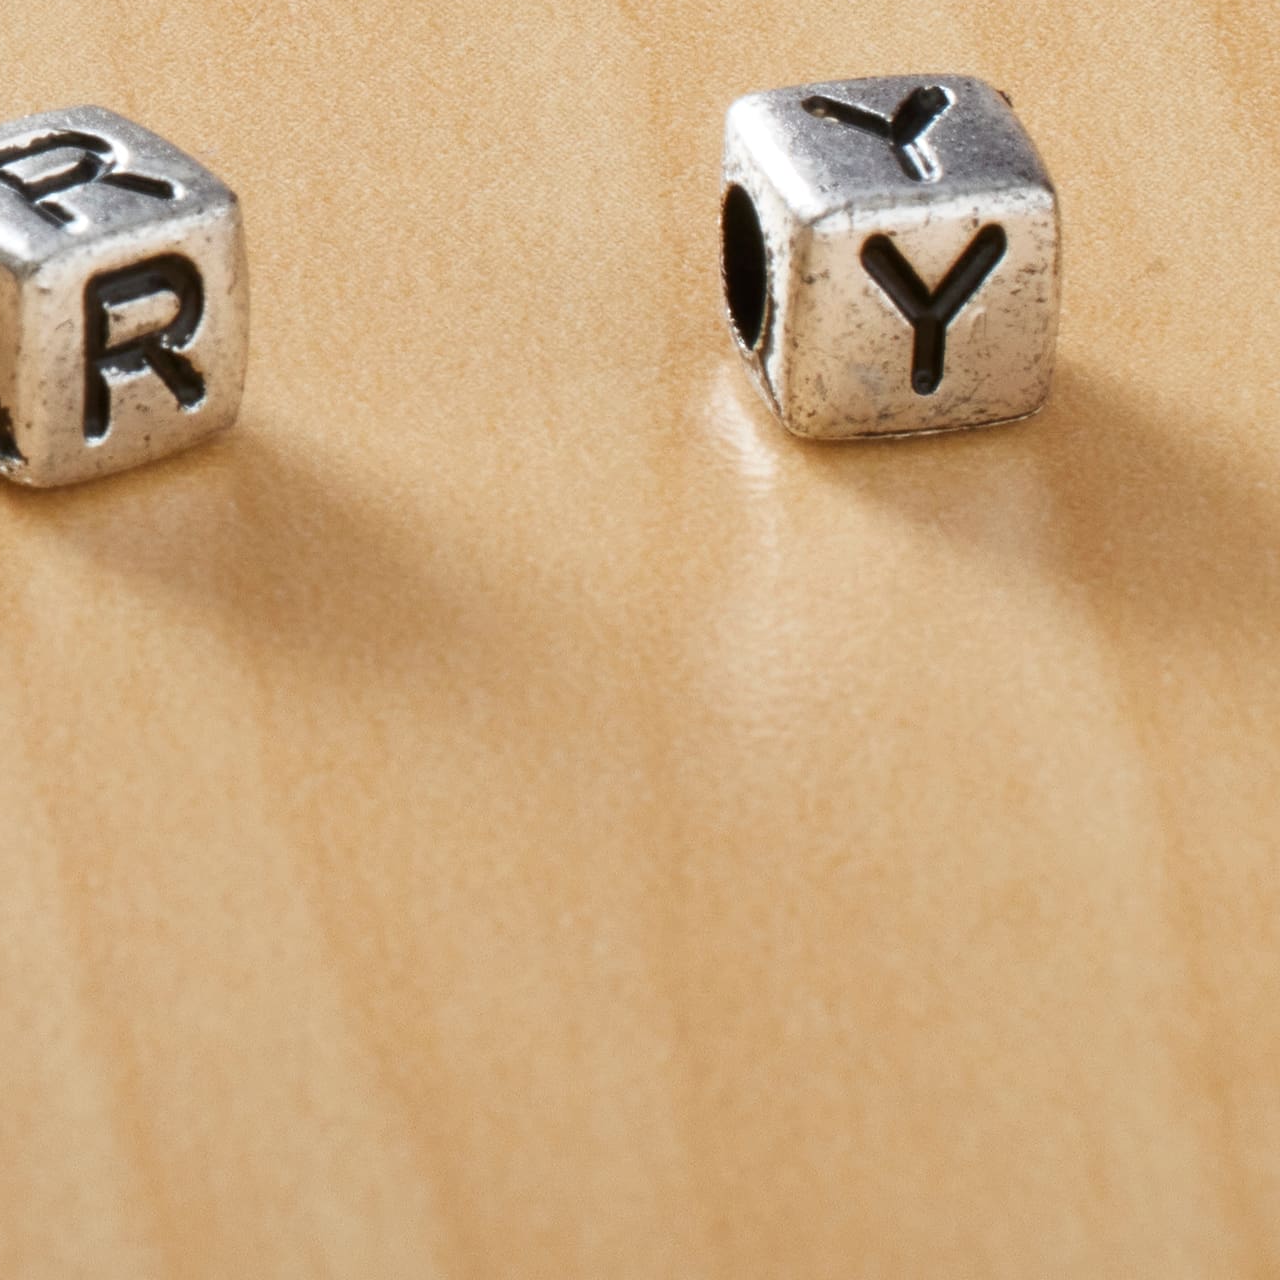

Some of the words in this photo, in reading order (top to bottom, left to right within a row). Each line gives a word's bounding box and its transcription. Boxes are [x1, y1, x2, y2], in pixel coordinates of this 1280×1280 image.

[800, 84, 957, 185] Y
[82, 251, 208, 447] R
[858, 220, 1010, 398] Y
